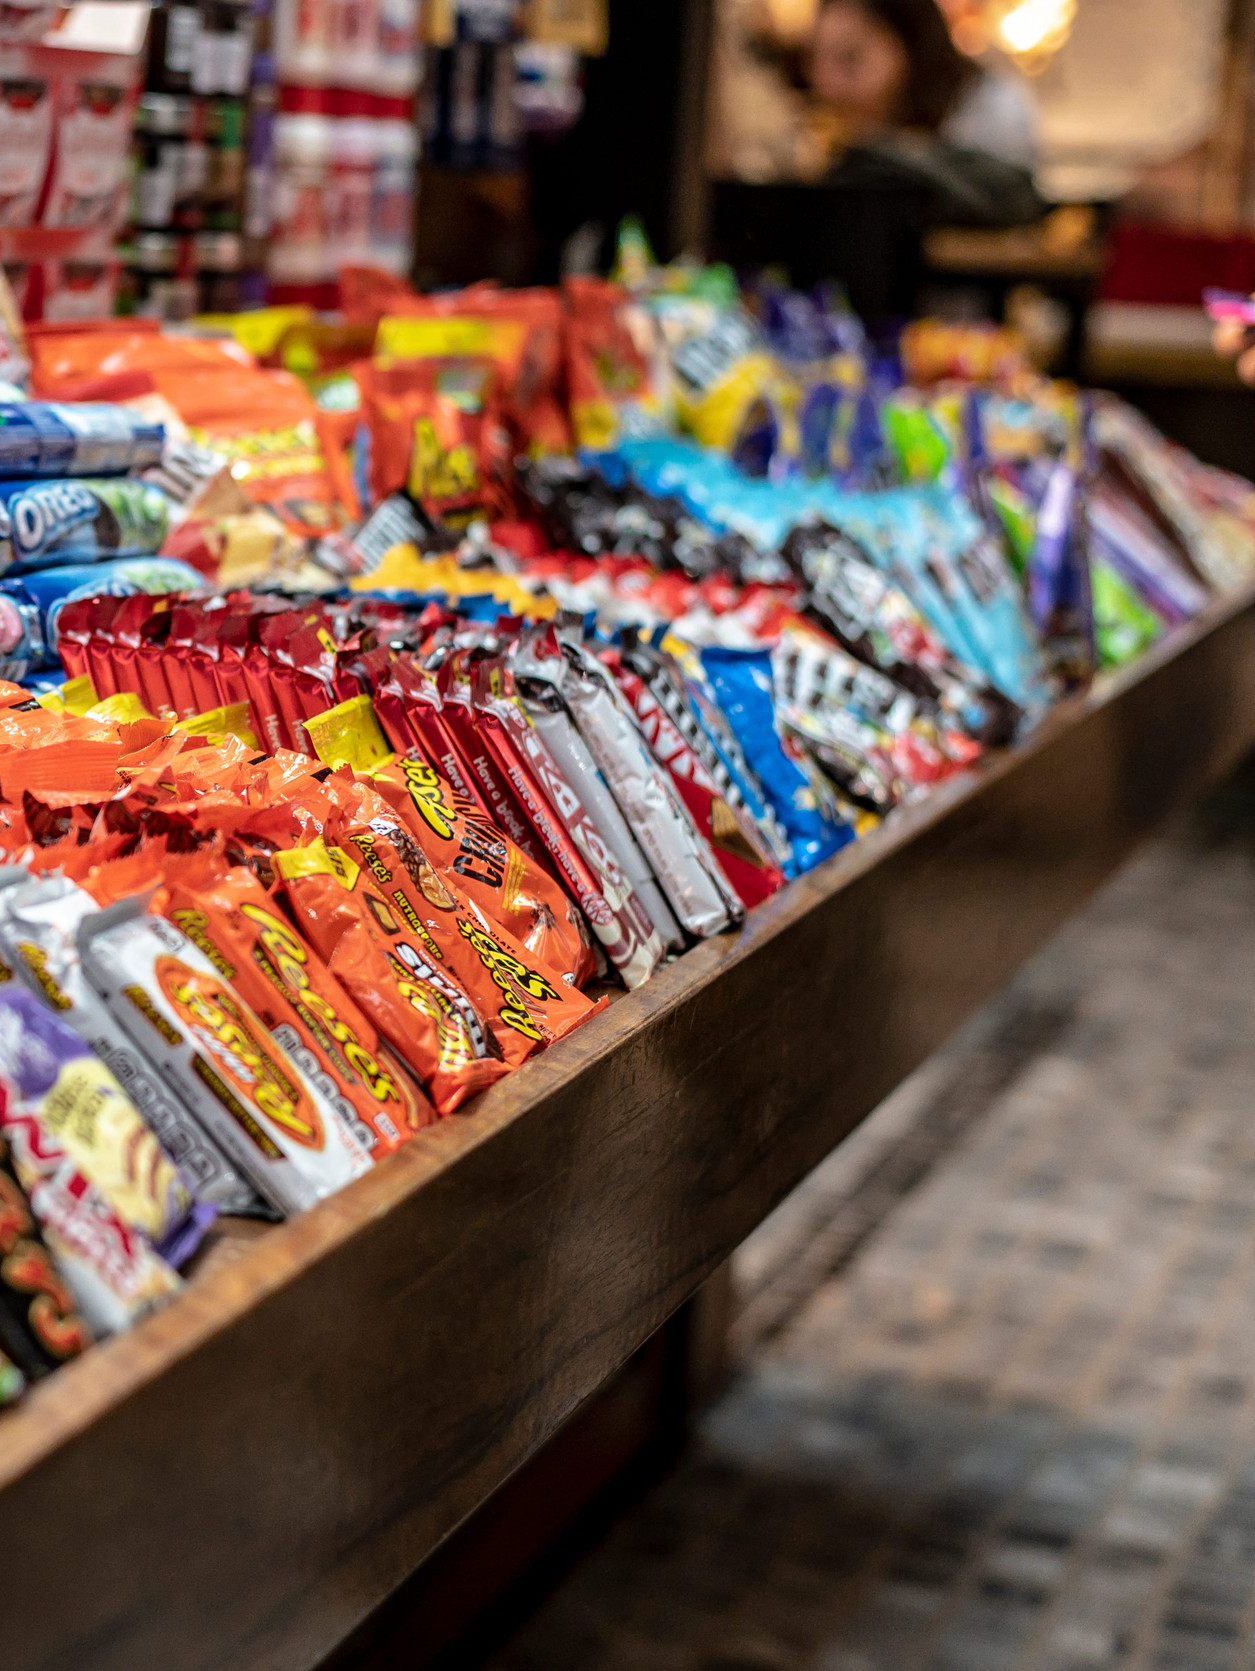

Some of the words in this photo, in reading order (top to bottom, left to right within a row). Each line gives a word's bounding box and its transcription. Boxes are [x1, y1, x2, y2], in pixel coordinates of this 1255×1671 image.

[15, 482, 94, 549] OREO
[441, 753, 465, 788] Have
[473, 755, 496, 791] Have
[491, 790, 500, 801] a
[349, 834, 393, 884] Reese's
[508, 765, 531, 801] Have
[527, 799, 537, 811] a
[558, 850, 581, 888] have
[576, 882, 587, 894] a
[171, 908, 236, 981] Reese's
[241, 903, 400, 1103] Reese's
